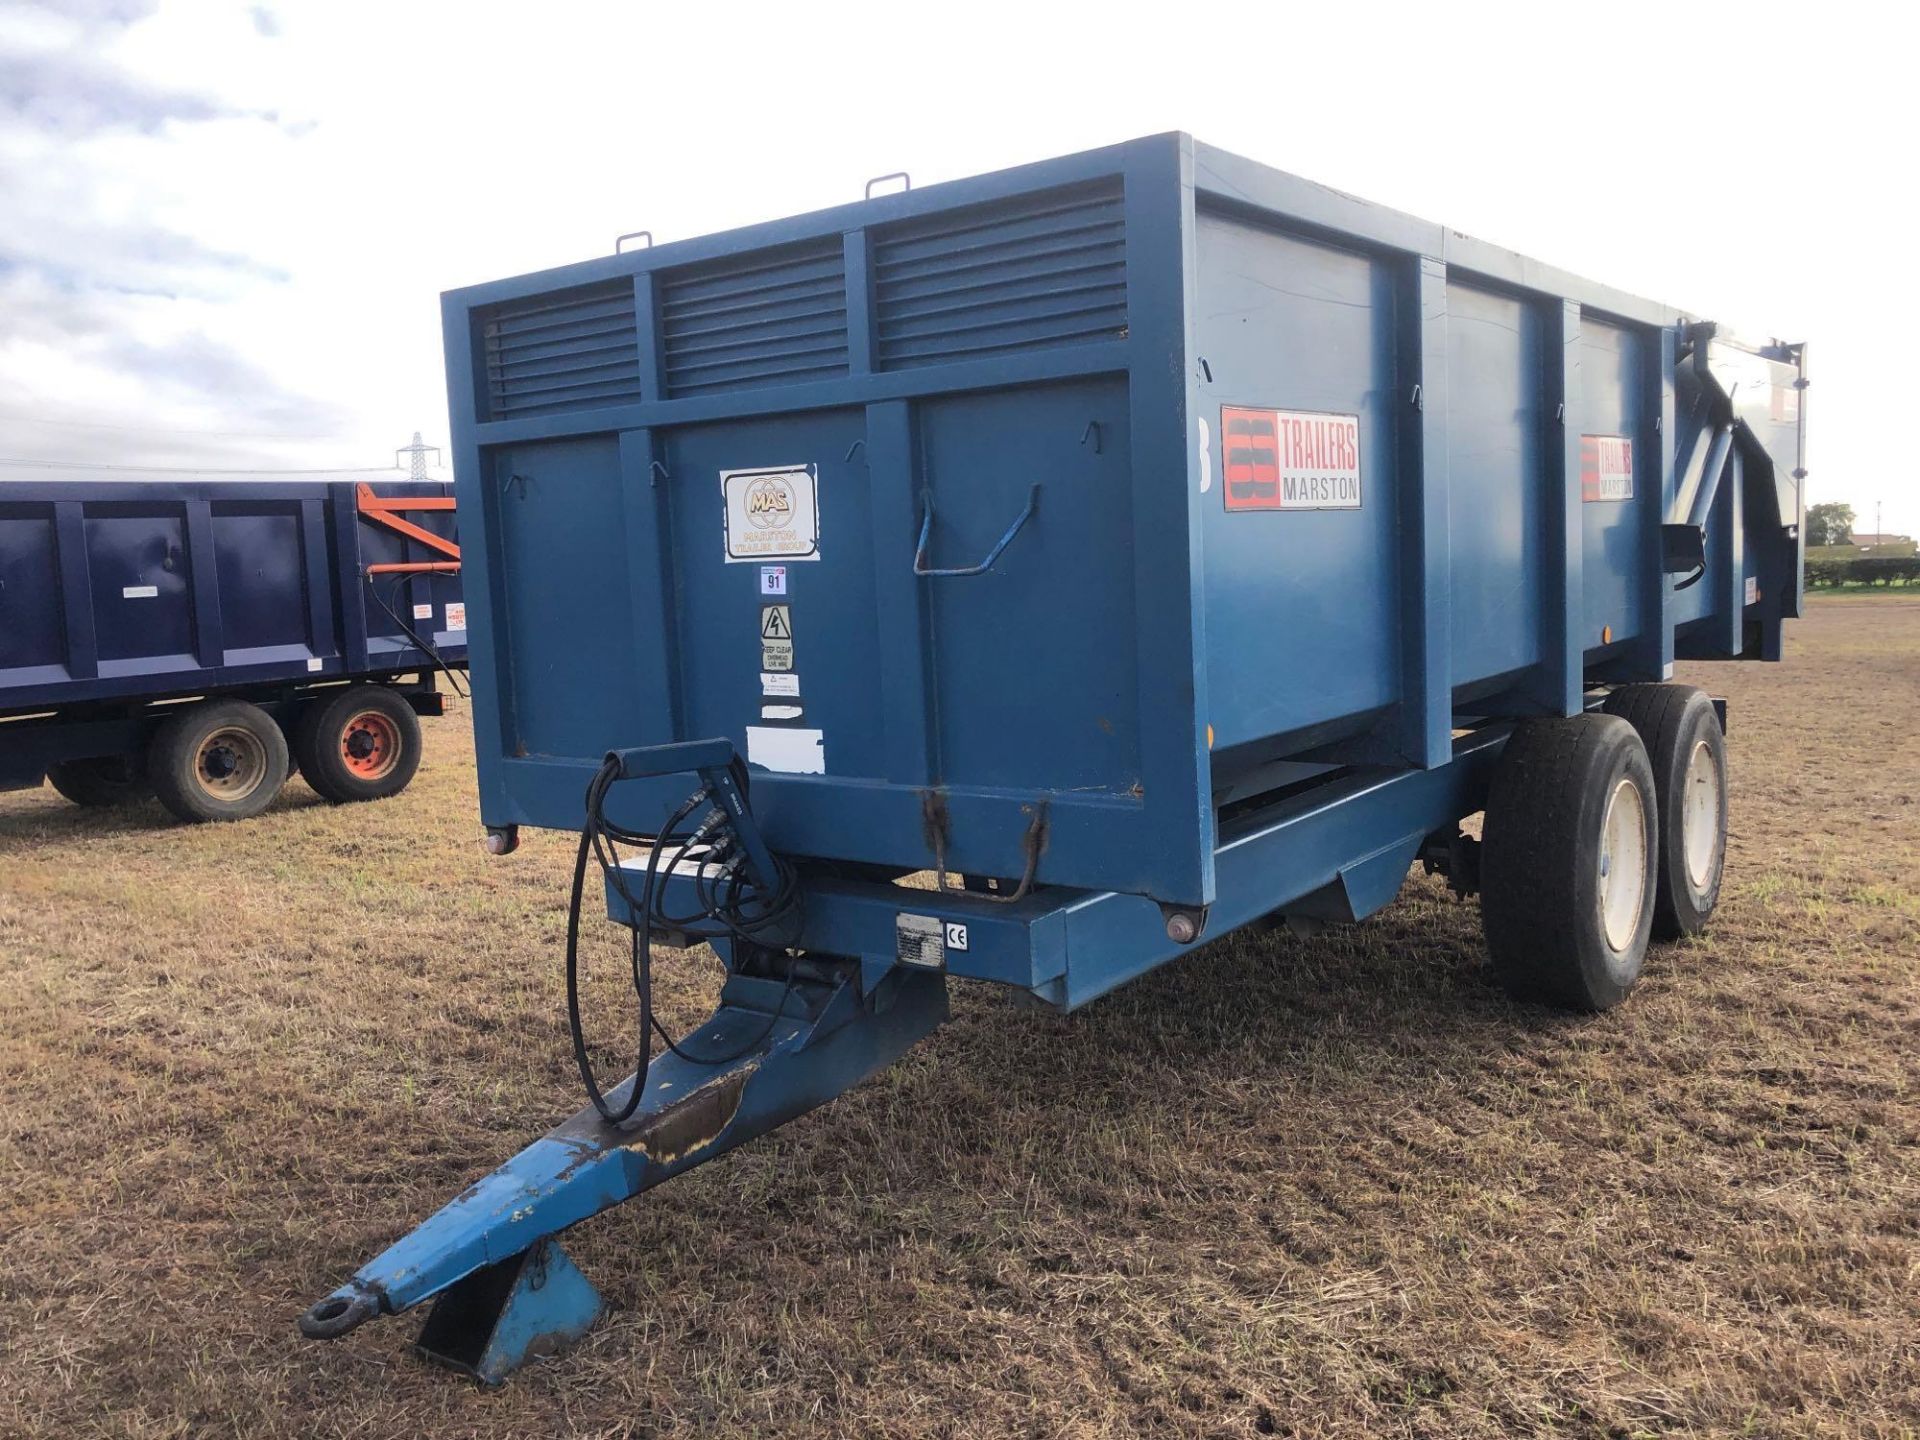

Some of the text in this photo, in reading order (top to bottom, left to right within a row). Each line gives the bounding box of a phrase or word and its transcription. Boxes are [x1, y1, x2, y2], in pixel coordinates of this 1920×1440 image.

[1281, 418, 1356, 470] TRAILERS
[1283, 476, 1357, 501] MARSTON
[750, 491, 789, 513] MAS
[743, 530, 797, 542] MARSTON
[768, 574, 780, 589] 91
[776, 646, 791, 654] CLEAR
[949, 928, 965, 945] CE
